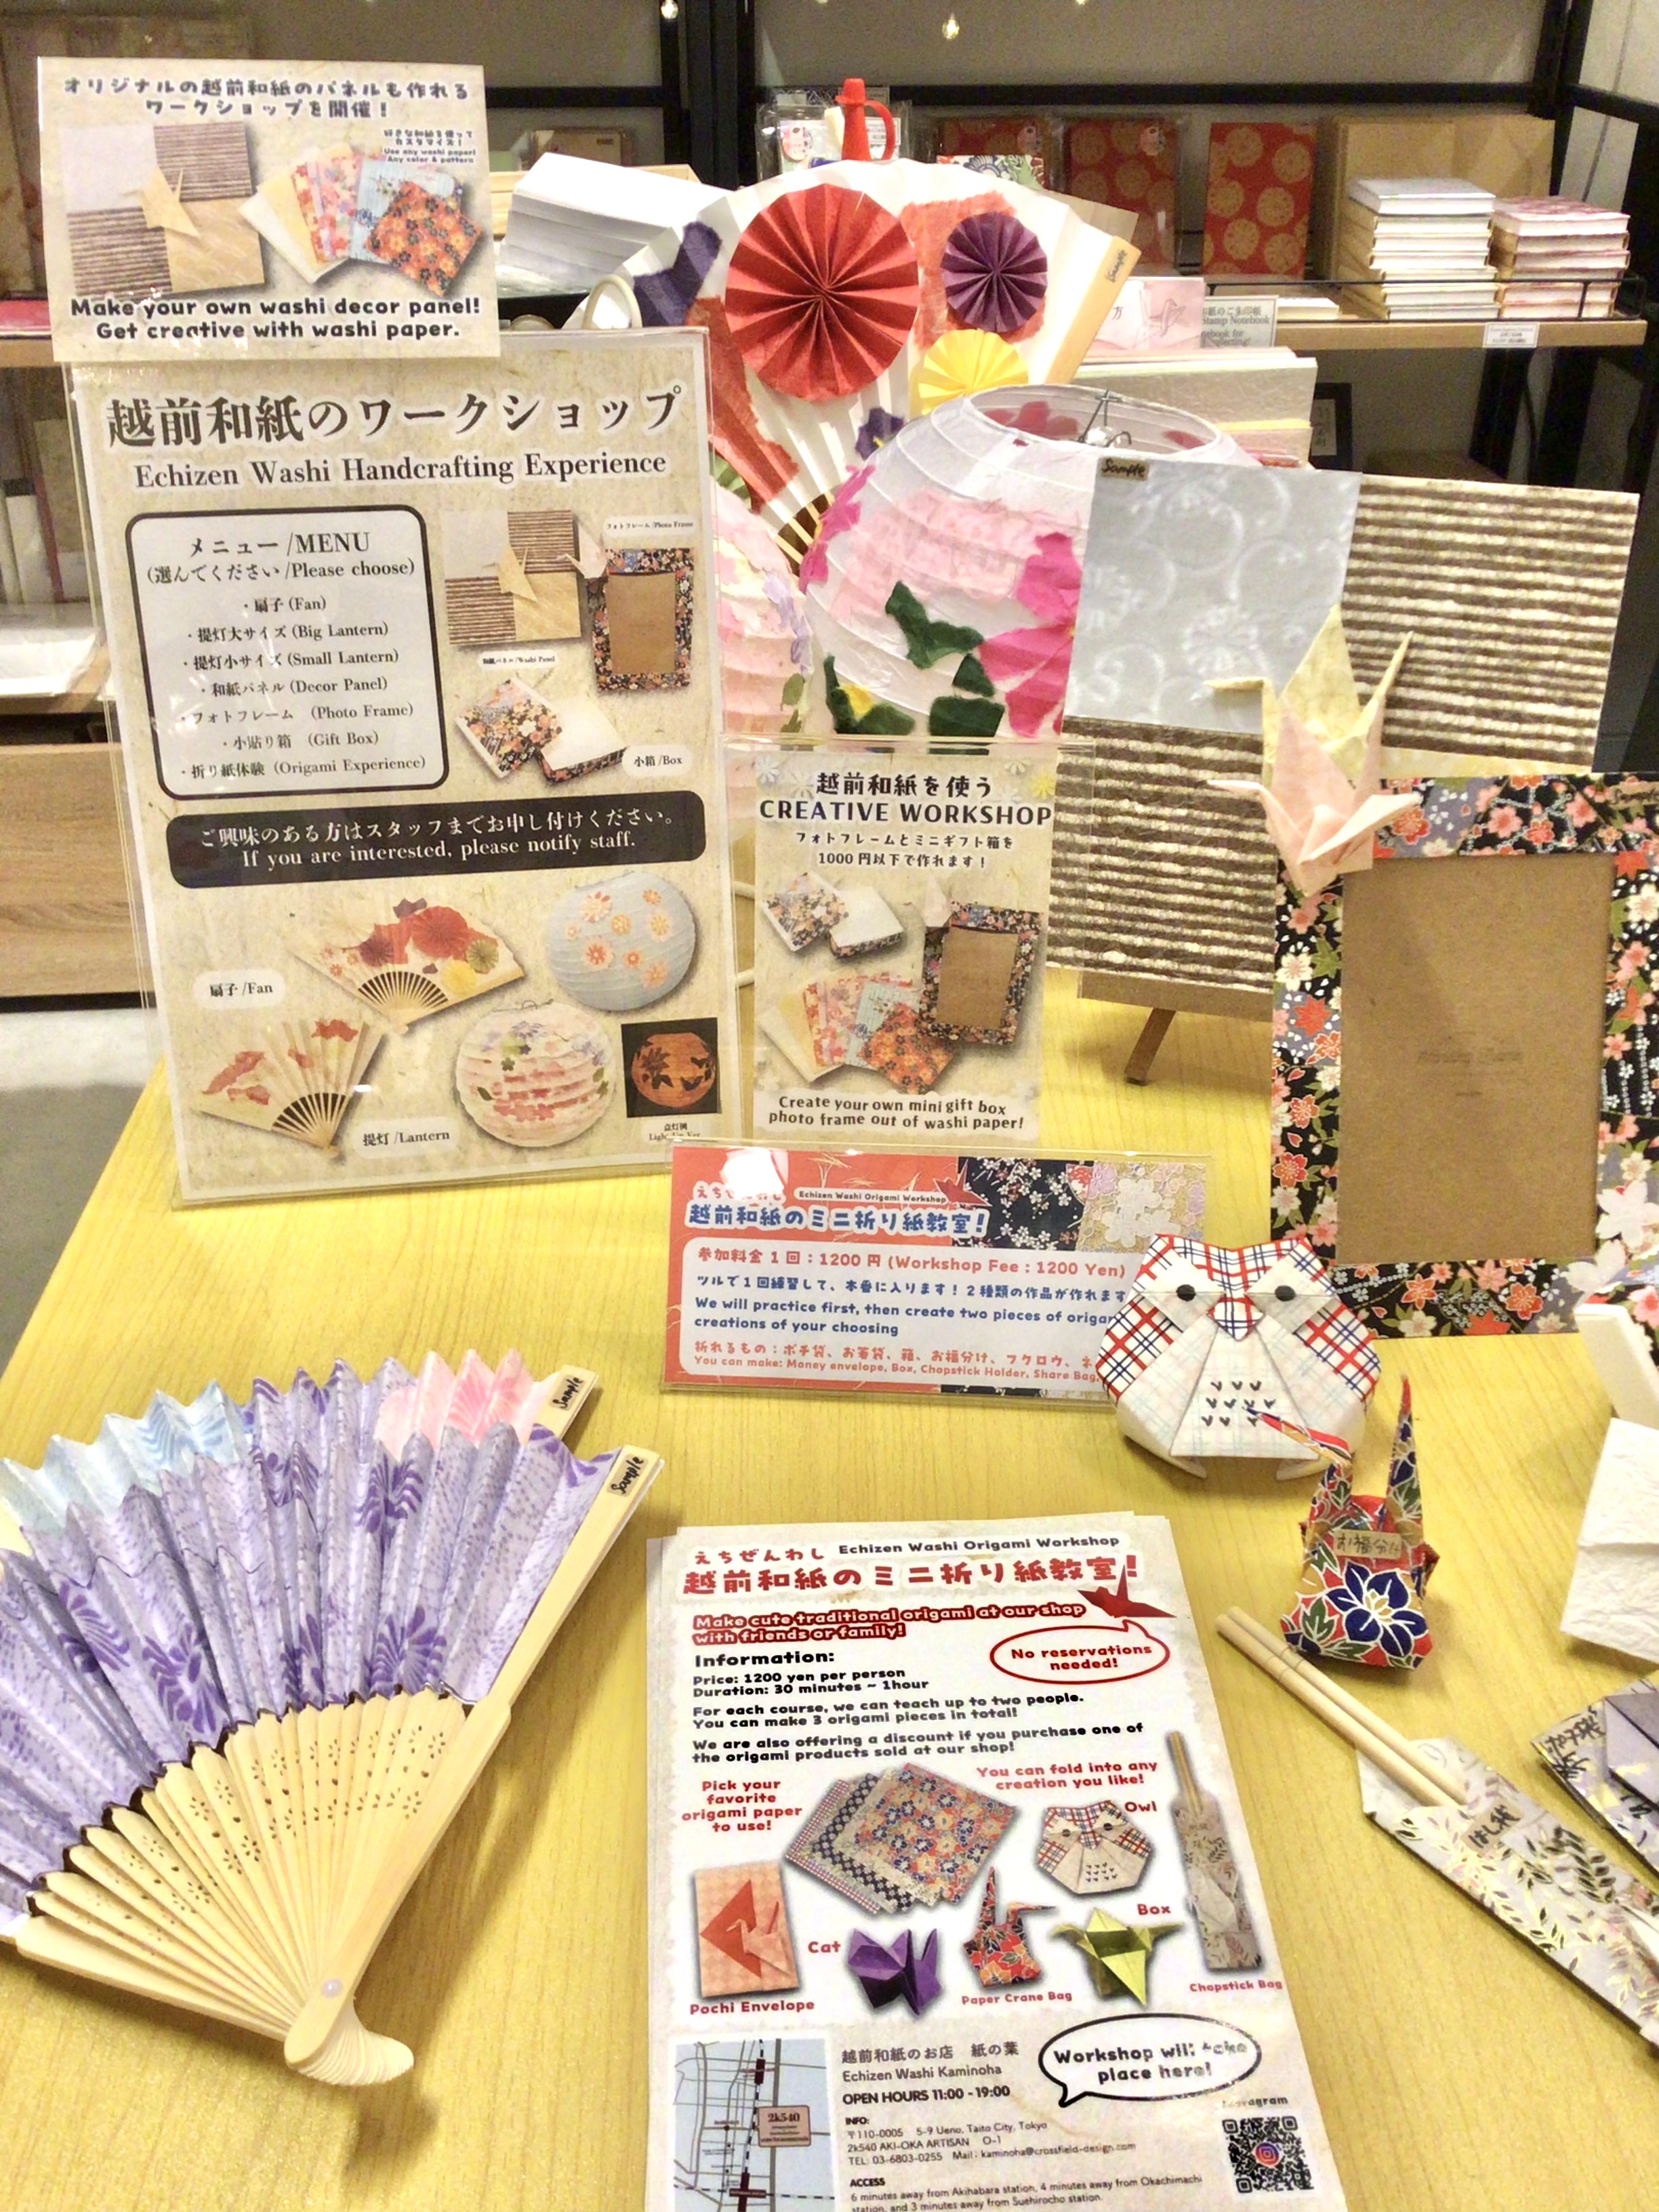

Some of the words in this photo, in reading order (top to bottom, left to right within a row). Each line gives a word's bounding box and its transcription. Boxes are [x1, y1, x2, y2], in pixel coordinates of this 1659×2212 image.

[64, 77, 468, 99] オリジナルの越前和紙のパネルも作れる
[71, 299, 134, 316] Make
[144, 300, 197, 319] your
[205, 302, 251, 315] own
[260, 297, 325, 314] washi
[335, 298, 400, 314] decor
[409, 297, 480, 317] panel!
[96, 322, 138, 339] Get
[147, 321, 245, 339] creative
[253, 321, 304, 338] with
[312, 320, 377, 337] washi
[386, 323, 459, 340] paper.
[106, 384, 682, 448] 越前和紙のワークショップ
[135, 464, 238, 489] Echizen
[249, 459, 331, 485] Washi
[340, 454, 514, 483] Handcrafting
[525, 451, 666, 482] Experience
[351, 558, 415, 577] choose)
[329, 621, 389, 638] Lantern)
[363, 702, 414, 718] Frame)
[816, 771, 992, 798] 越前和紙を使う
[759, 800, 890, 822] CREATIVE
[900, 803, 1052, 825] WORKSHOP
[201, 808, 673, 848] ご興味のある方はスタッフまでお申し付けください。
[796, 832, 1014, 850] フォトフレームとミニギフト箱を
[241, 849, 259, 867] If
[268, 853, 302, 872] you
[310, 851, 342, 864] are
[350, 840, 452, 863] interested,
[460, 839, 520, 861] please
[528, 834, 581, 855] notify
[590, 830, 636, 848] staff.
[779, 1096, 831, 1108] Create
[834, 1099, 869, 1111] your
[872, 1101, 904, 1111] own
[909, 1100, 943, 1113] mini
[945, 1098, 974, 1114] gift
[977, 1100, 1007, 1116] box
[769, 1110, 814, 1126] photo
[819, 1112, 865, 1126] frame
[870, 1113, 897, 1127] out
[902, 1114, 920, 1128] of
[924, 1115, 968, 1130] washi
[972, 1115, 1024, 1130] paper!
[799, 1190, 832, 1199] Echizen
[835, 1191, 862, 1200] Washi
[865, 1193, 899, 1202] Origami
[903, 1194, 947, 1204] Workshop
[688, 1204, 987, 1235] 越前和紙のミニ折り紙教室！
[1085, 1263, 1126, 1279] Yen)
[695, 1296, 717, 1309] We
[722, 1298, 748, 1310] will
[753, 1299, 816, 1313] practice
[821, 1301, 860, 1315] first,
[865, 1303, 899, 1315] then
[905, 1307, 955, 1318] create
[960, 1307, 988, 1319] two
[994, 1308, 1041, 1322] pieces
[1046, 1311, 1062, 1322] of
[695, 1317, 766, 1329] creations
[771, 1319, 787, 1330] of
[792, 1322, 827, 1333] your
[832, 1322, 899, 1336] choosing
[838, 1544, 902, 1555] Echizen
[908, 1541, 958, 1552] Washi
[964, 1538, 1031, 1551] Origami
[1036, 1536, 1120, 1548] Workshop
[695, 1548, 825, 1565] えちぜんわし
[682, 1554, 1137, 1595] 越前和紙のミニ折り紙教室！
[696, 1615, 745, 1628] Make
[750, 1613, 791, 1626] cute
[796, 1610, 897, 1624] traditional
[903, 1607, 972, 1622] origami
[979, 1605, 997, 1618] at
[1004, 1605, 1035, 1616] our
[1041, 1603, 1084, 1617] shop
[695, 1630, 735, 1644] with
[741, 1628, 807, 1643] friends
[813, 1629, 832, 1640] or
[839, 1624, 904, 1639] family!
[695, 1651, 835, 1668] Information:
[1011, 1649, 1035, 1659] No
[1041, 1645, 1152, 1658] reservations
[1050, 1658, 1118, 1671] needed!
[693, 1675, 739, 1685] Price:
[744, 1673, 781, 1683] 1200
[787, 1673, 815, 1683] yen
[820, 1671, 846, 1682] per
[852, 1668, 905, 1681] person
[977, 1767, 1012, 1777] You
[1015, 1766, 1046, 1776] can
[1050, 1763, 1082, 1774] fold
[1088, 1762, 1122, 1773] into
[1128, 1761, 1158, 1773] any
[996, 1778, 1067, 1790] creation
[1073, 1778, 1103, 1788] you
[1108, 1774, 1145, 1786] like!
[1124, 1801, 1157, 1813] Owl
[1137, 1904, 1171, 1916] Box
[808, 1940, 841, 1954] Cat
[1189, 1981, 1254, 1993] Chopstick
[1258, 1979, 1283, 1992] Bag
[690, 2002, 735, 2015] Pochi
[741, 2000, 815, 2013] Envelope
[961, 1994, 1000, 2006] Paper
[1004, 1992, 1044, 2003] Crane
[1048, 1991, 1073, 2003] Bag
[841, 2045, 954, 2064] 越前和紙のお店
[970, 2041, 1019, 2057] 紙の葉
[842, 2070, 893, 2082] Echizen
[895, 2066, 934, 2080] Washi
[938, 2064, 1002, 2078] Kaminoha
[842, 2092, 878, 2105] OPEN
[882, 2089, 929, 2103] HOURS
[932, 2087, 964, 2101] 11:00
[976, 2085, 1010, 2098] 19:00
[847, 2144, 877, 2153] 2k540
[880, 2140, 924, 2151] AKI-OKA
[926, 2137, 969, 2148] ARTISAN
[850, 2177, 886, 2188] ACCESS
